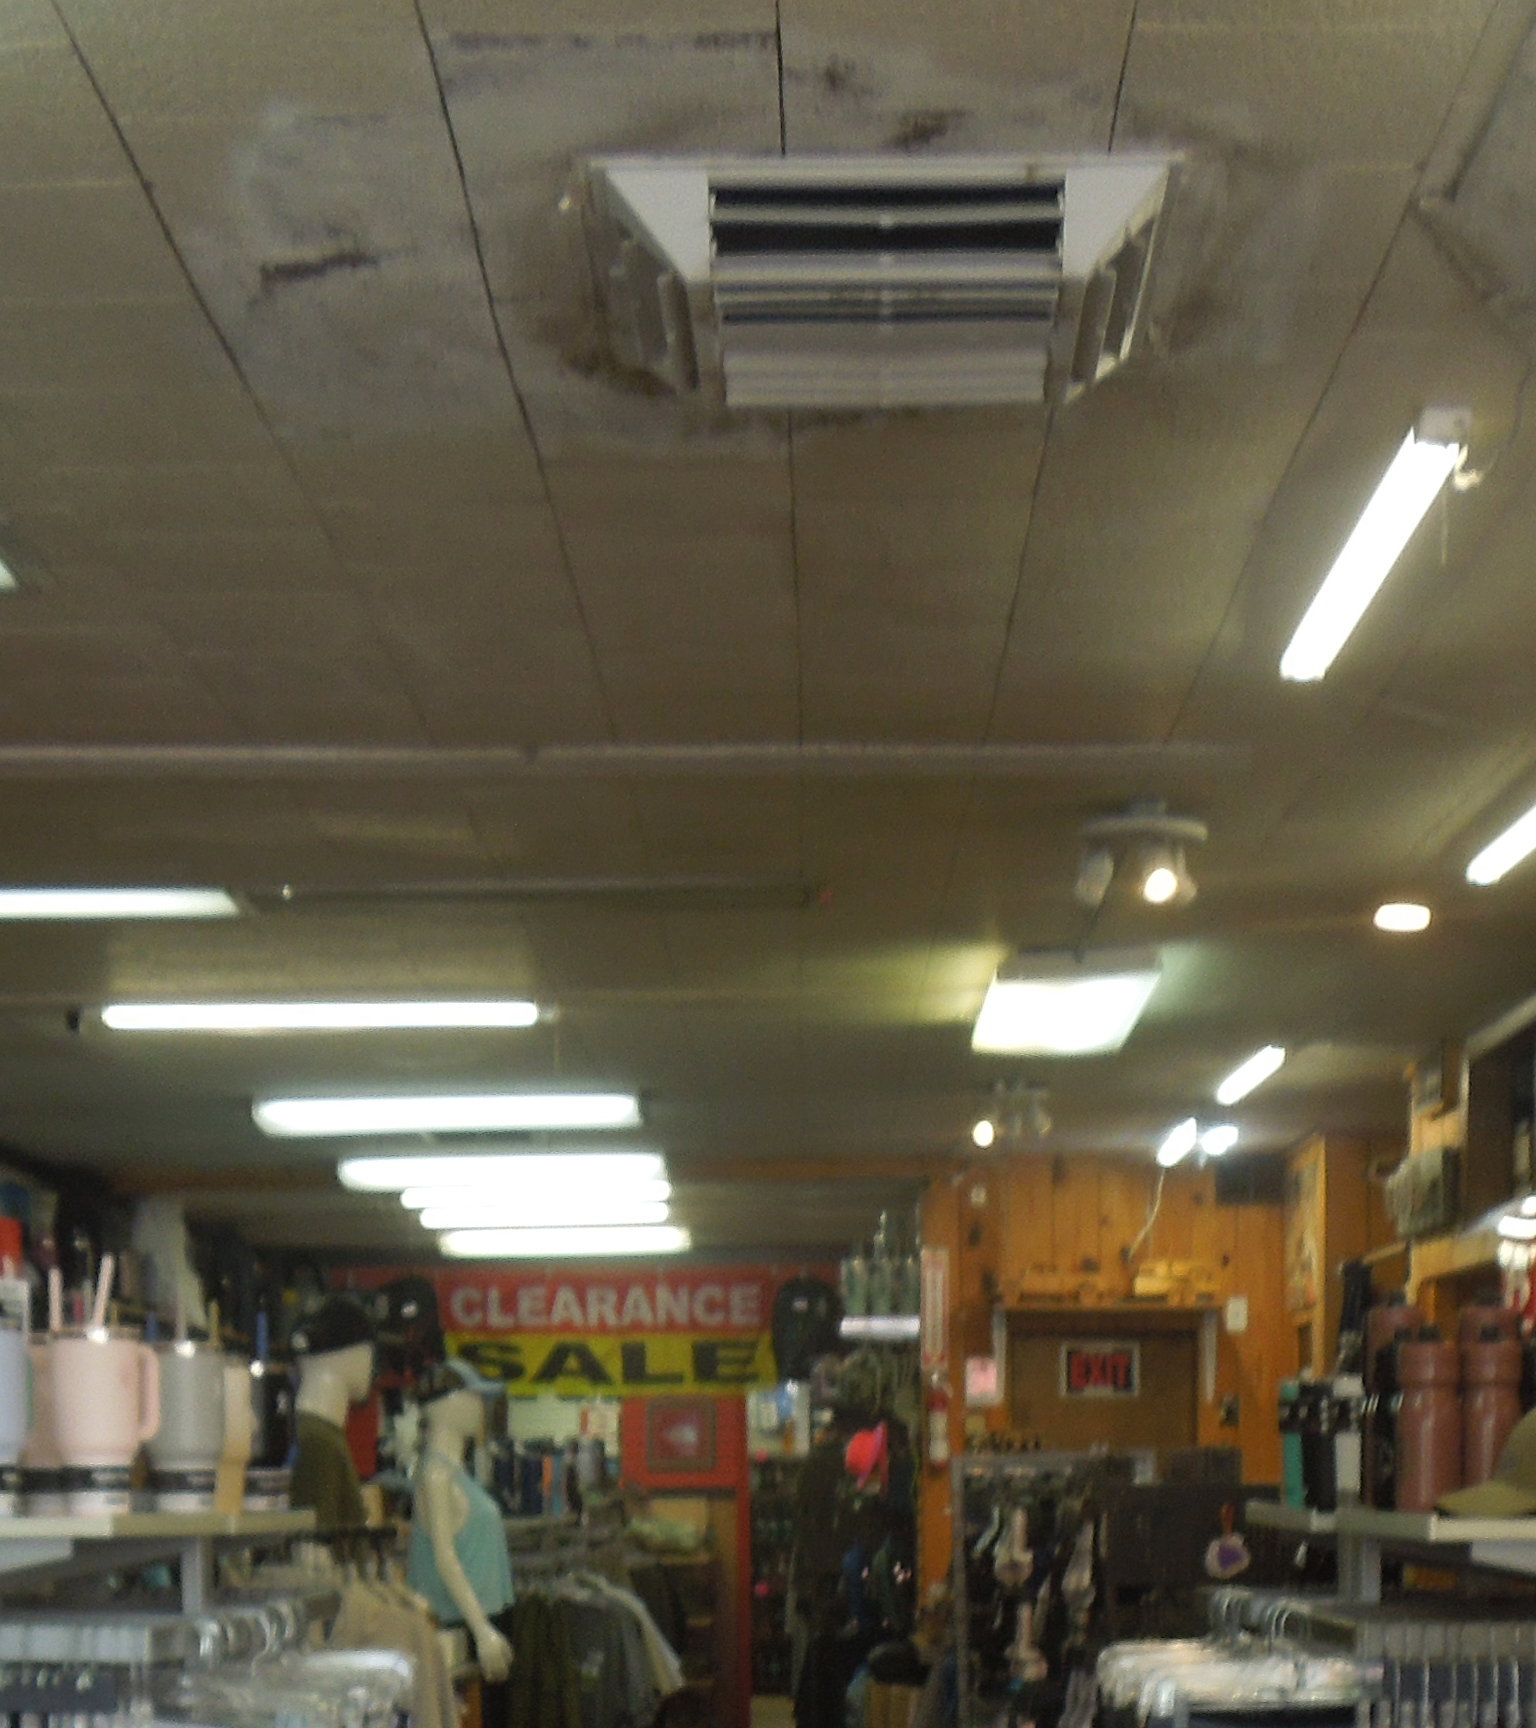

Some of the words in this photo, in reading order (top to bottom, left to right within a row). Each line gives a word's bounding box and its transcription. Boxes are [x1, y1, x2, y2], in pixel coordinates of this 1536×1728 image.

[450, 1283, 762, 1328] CLEARANCE
[457, 1339, 762, 1387] SALE
[1070, 1352, 1131, 1391] EXIT
